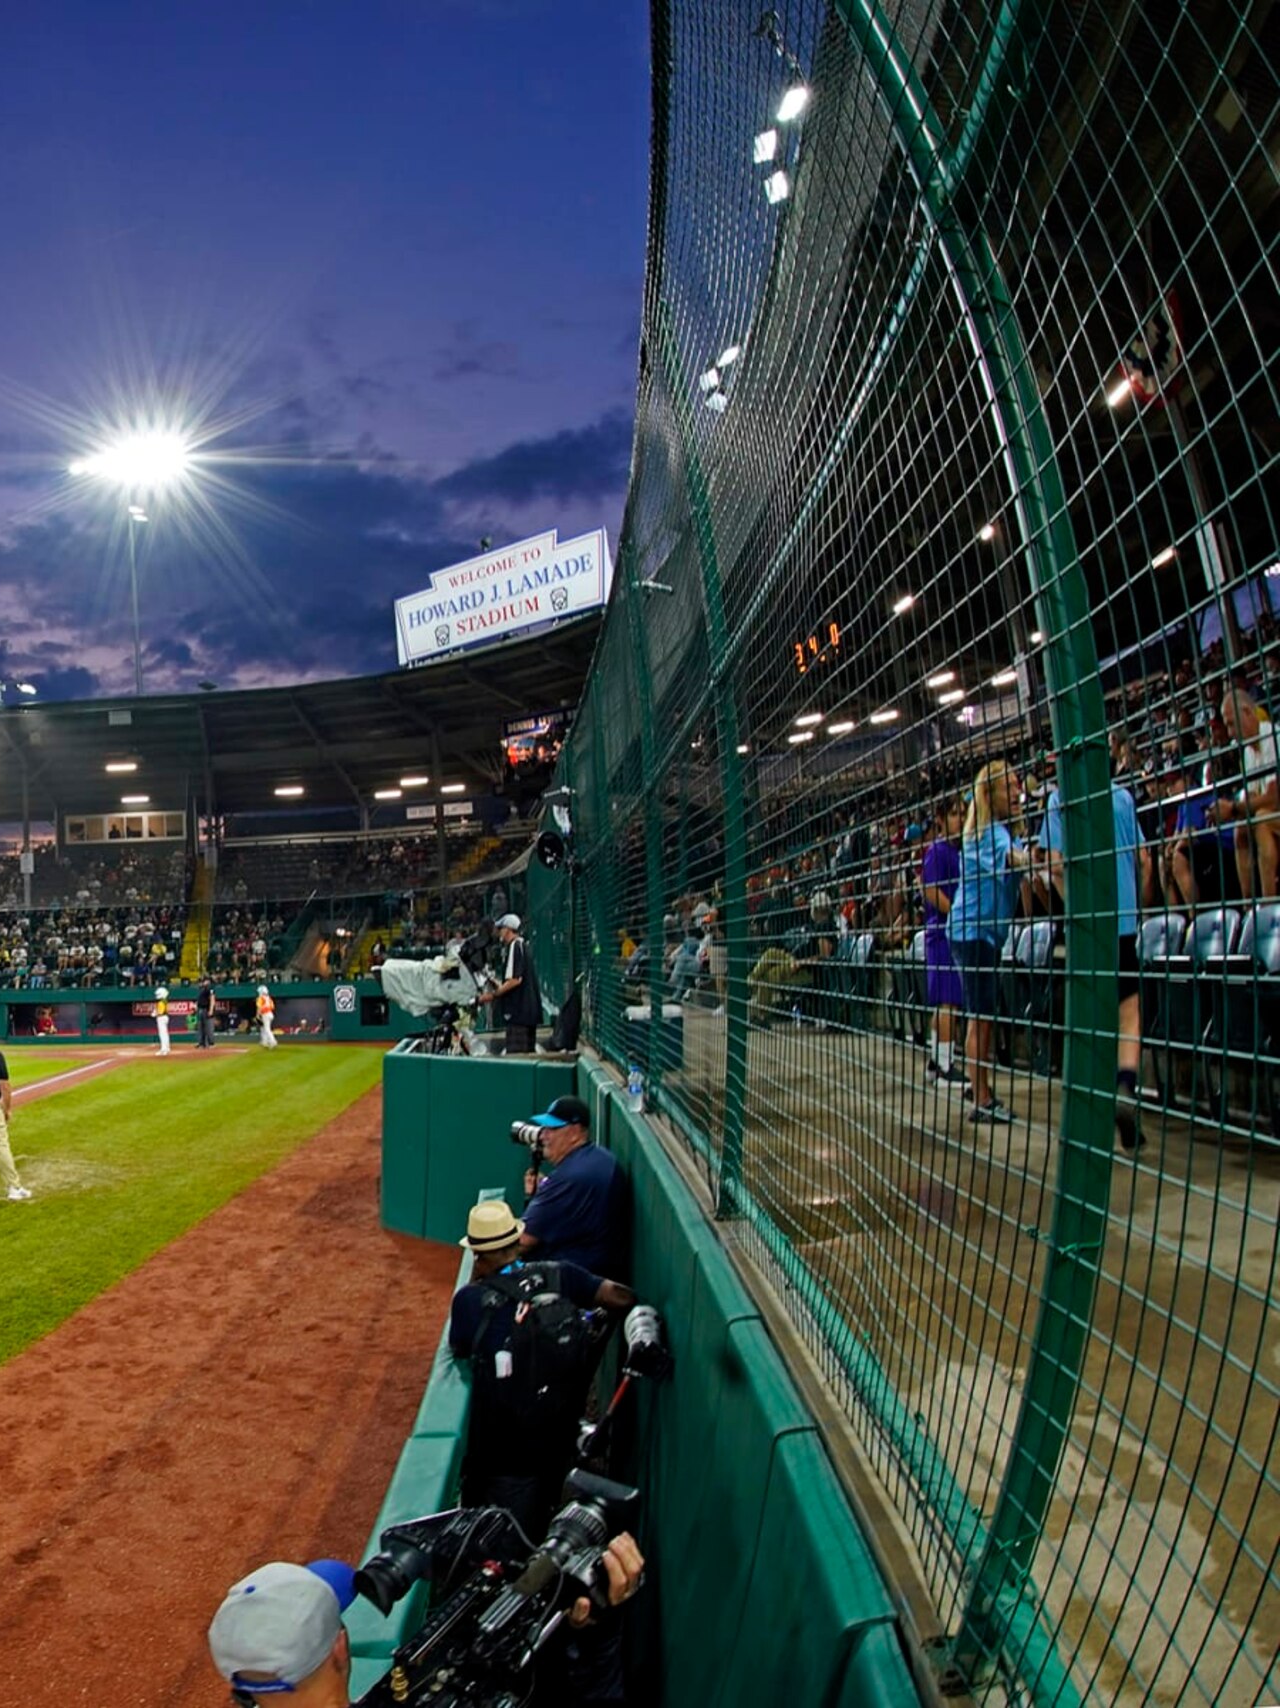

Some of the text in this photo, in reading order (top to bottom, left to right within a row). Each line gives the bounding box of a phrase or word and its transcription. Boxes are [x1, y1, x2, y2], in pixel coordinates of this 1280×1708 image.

[448, 548, 541, 588] WELCOME TO
[408, 553, 594, 629] HOWARD J. LAMADE
[457, 596, 540, 635] STADIUM
